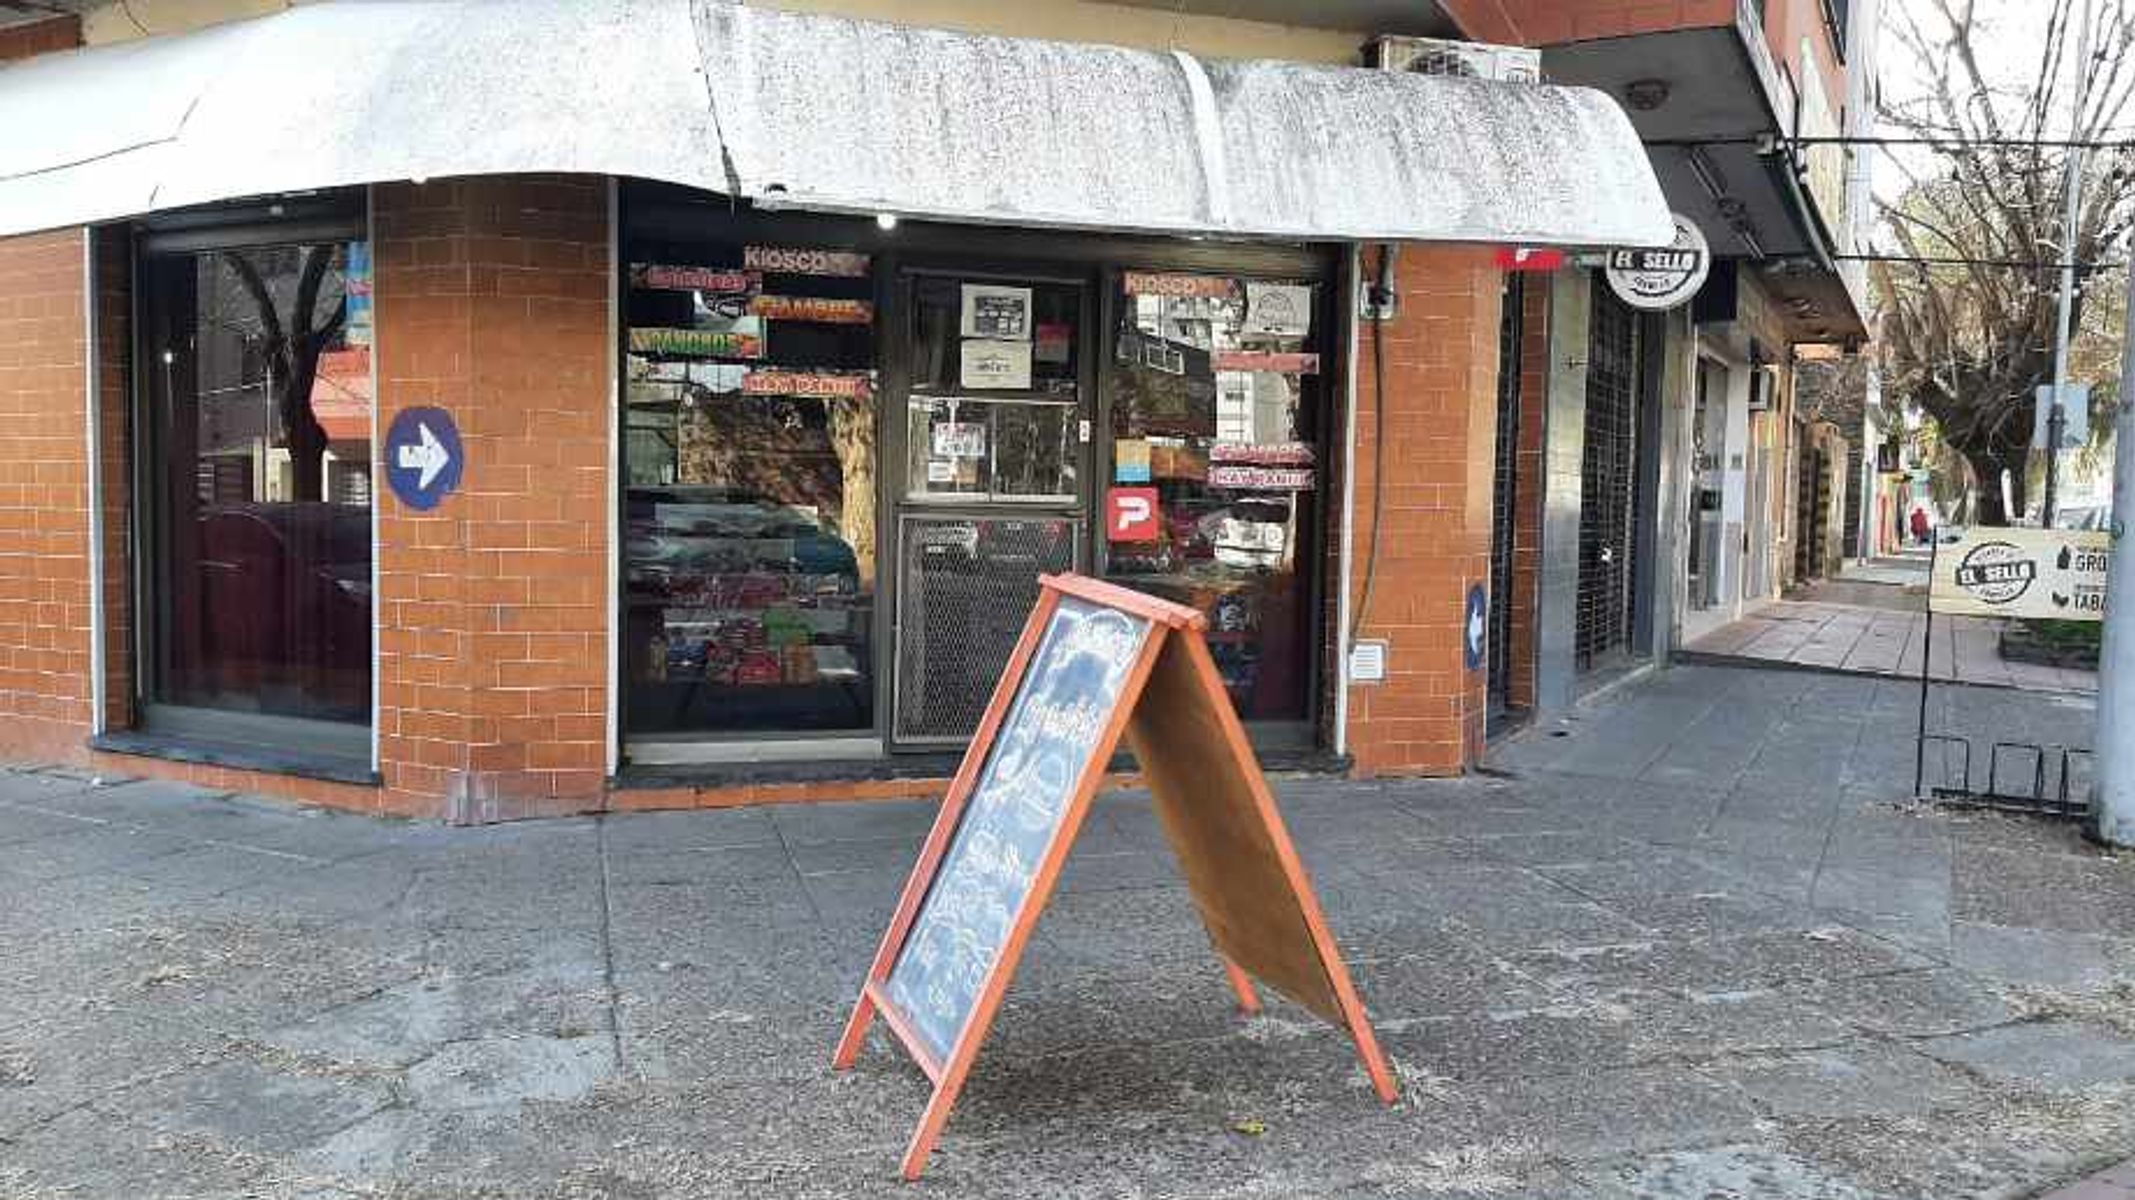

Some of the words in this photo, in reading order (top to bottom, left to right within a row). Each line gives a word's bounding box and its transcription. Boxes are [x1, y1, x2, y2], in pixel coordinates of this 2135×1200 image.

[744, 247, 825, 271] KIOSCO
[1643, 252, 1695, 270] SELLO
[1960, 570, 1977, 585] EL
[1985, 564, 2030, 582] SELLO
